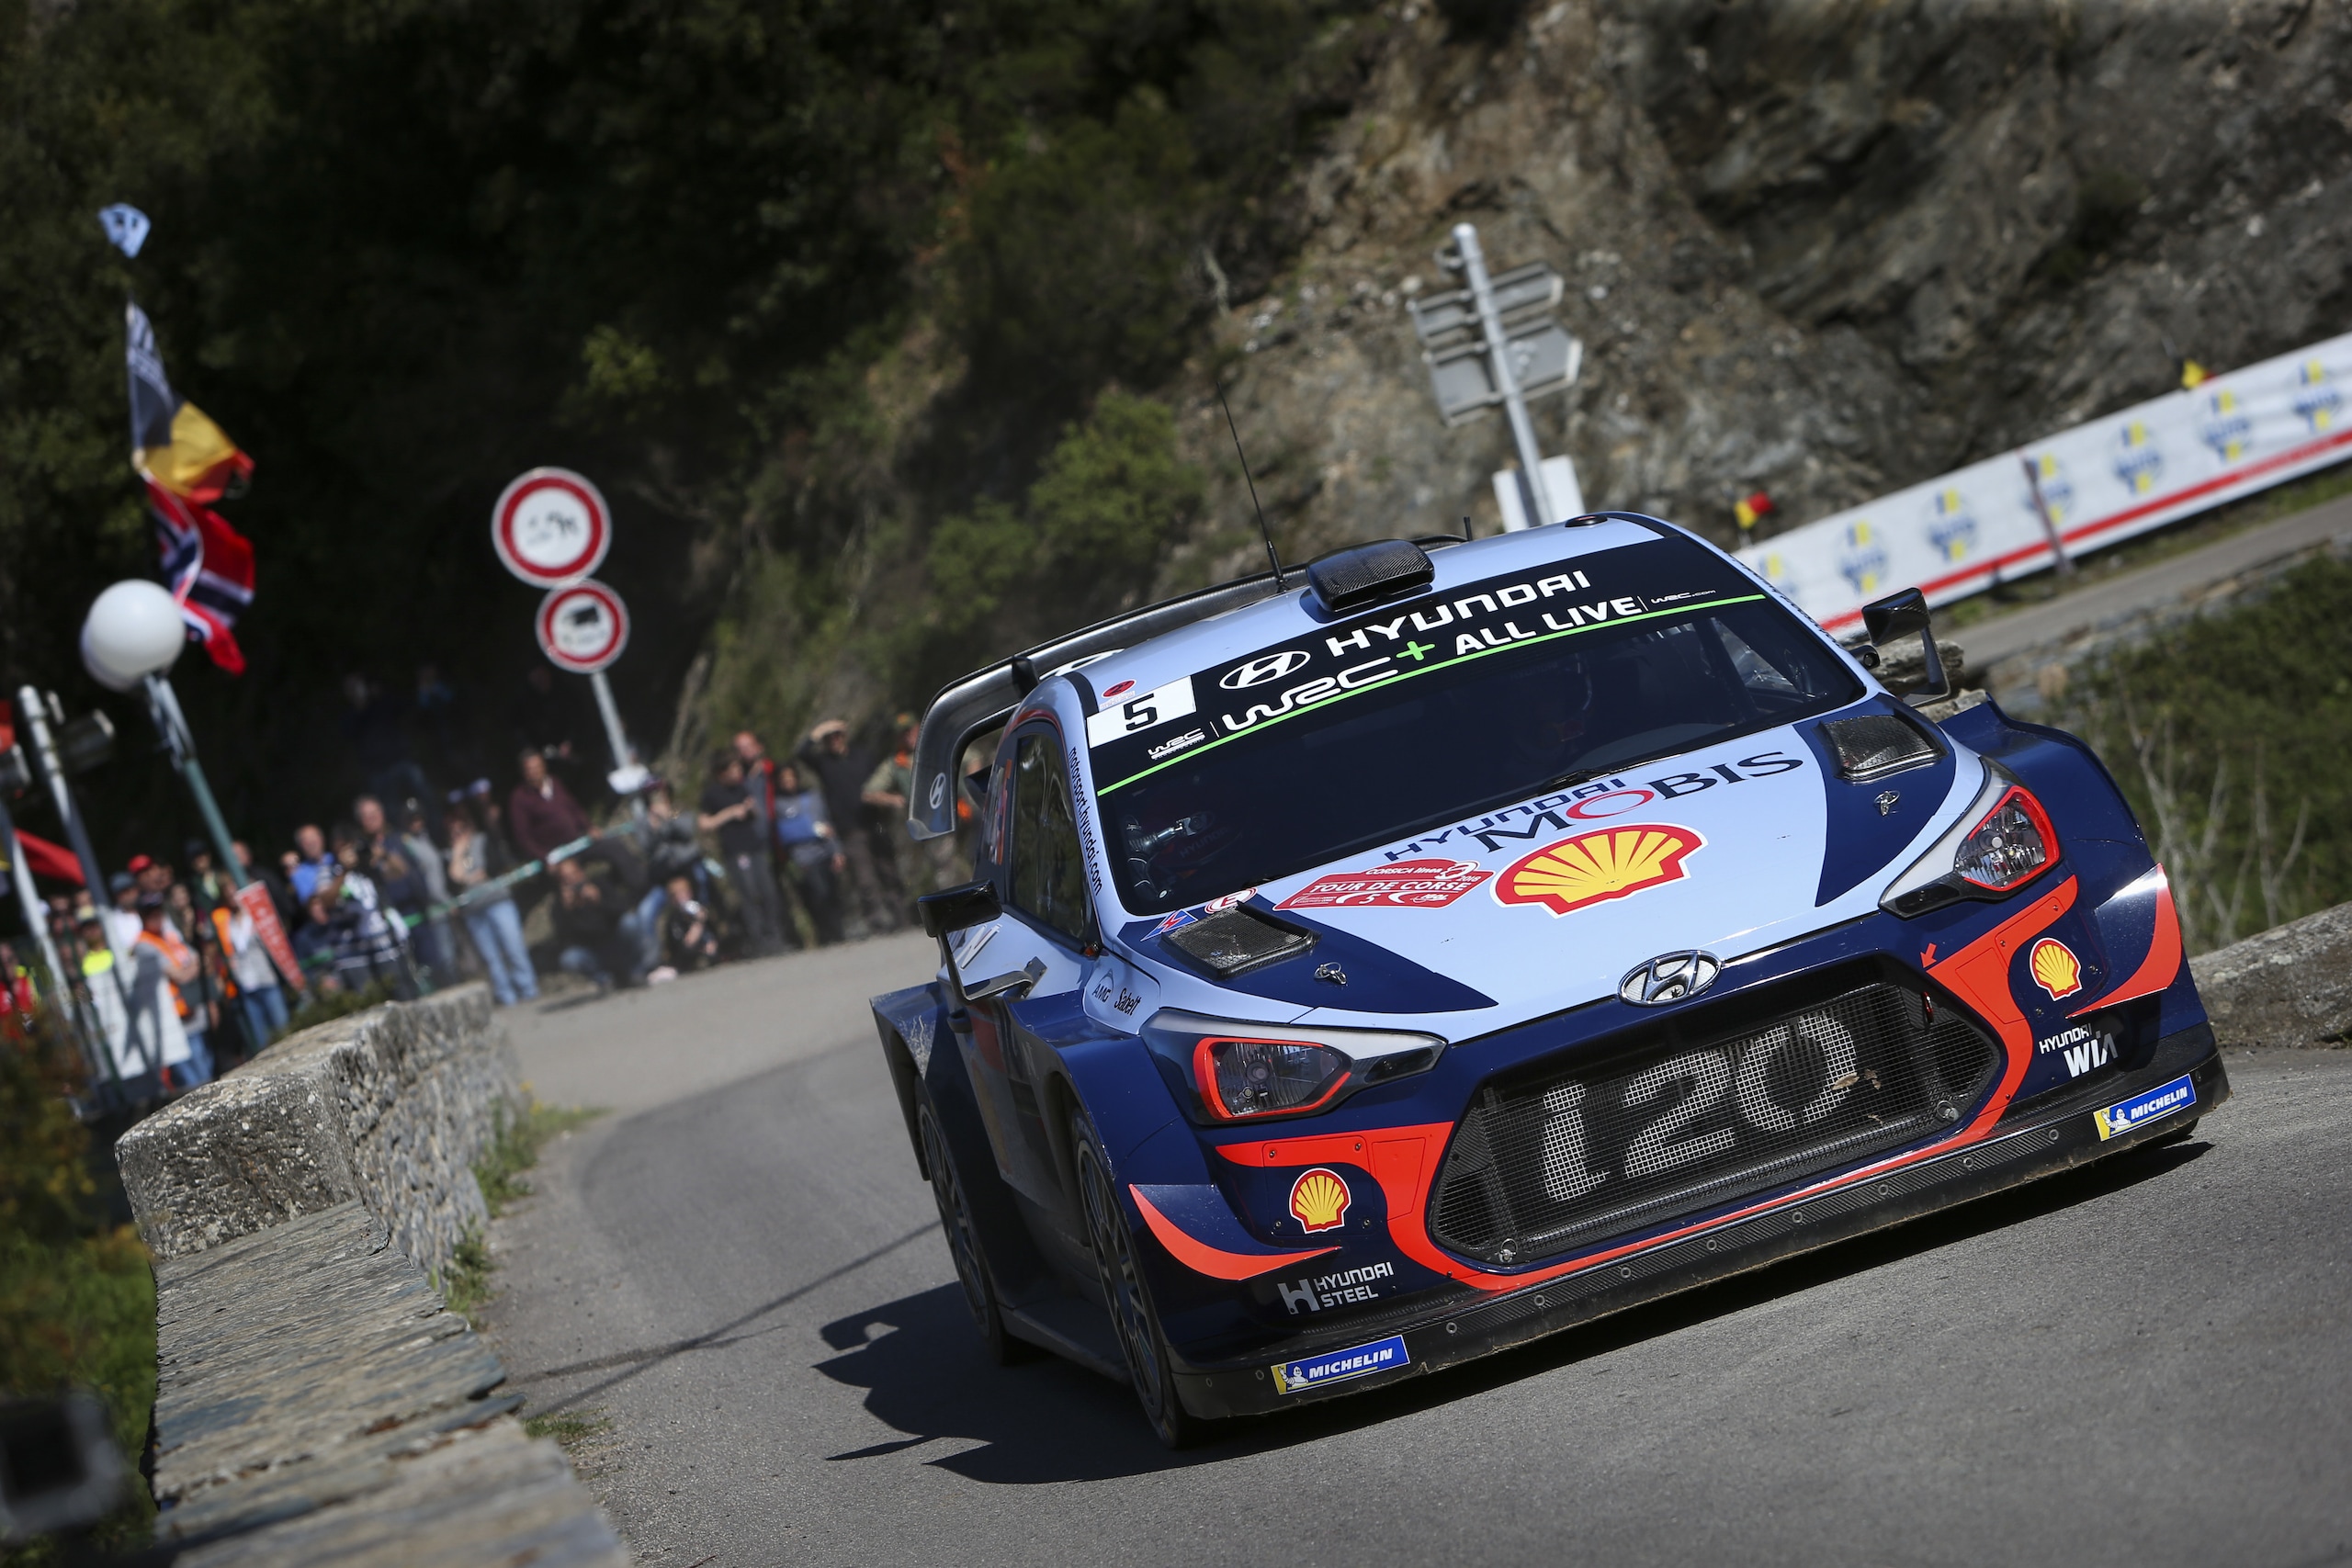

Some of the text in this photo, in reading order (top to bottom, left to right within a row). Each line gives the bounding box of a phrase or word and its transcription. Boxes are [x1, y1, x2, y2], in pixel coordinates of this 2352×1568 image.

[1326, 570, 1592, 658] HYUNDAI
[1456, 595, 1644, 656] ALL LIVE
[1123, 693, 1158, 731] 5
[1148, 728, 1204, 756] WRC
[1470, 750, 1804, 853] MOBIS
[1069, 746, 1103, 897] motorsport.hyundai.com
[1385, 777, 1627, 862] HYUNDAI
[1310, 881, 1472, 893] TOUR DE CORSE
[1365, 866, 1415, 875] CORSICA
[1358, 894, 1382, 905] 5
[1114, 987, 1142, 1016] Sabelt
[2039, 1022, 2093, 1055] HYUNDAI
[2130, 1086, 2188, 1120] MICHELIN
[1313, 1261, 1395, 1292] HYUNDAI
[1319, 1284, 1379, 1308] STEEL
[1308, 1347, 1394, 1380] MICHELIN
